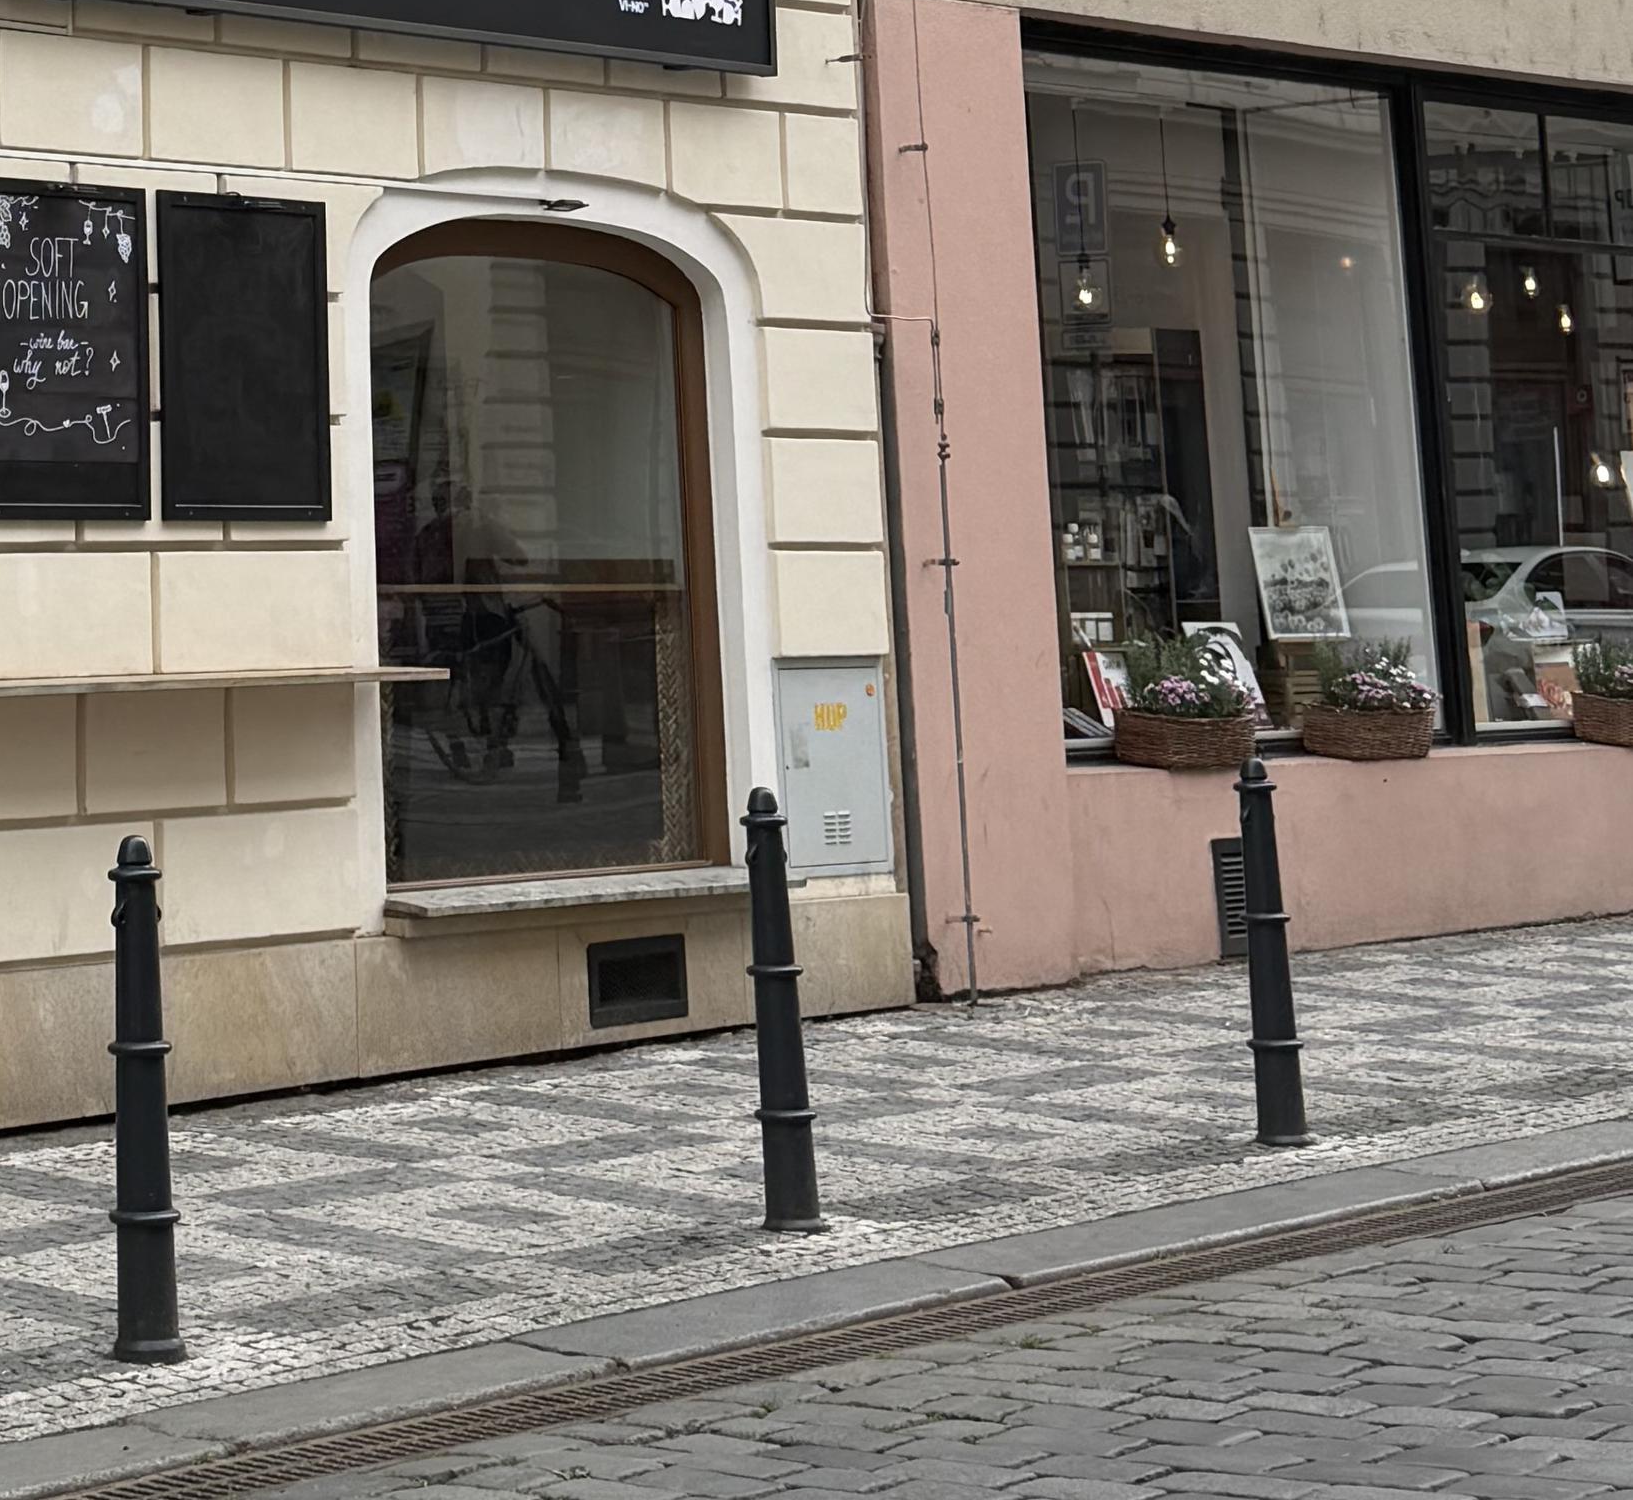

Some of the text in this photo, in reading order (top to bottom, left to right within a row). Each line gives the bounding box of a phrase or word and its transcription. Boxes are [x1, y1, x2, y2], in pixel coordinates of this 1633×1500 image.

[25, 237, 79, 278] SOFT
[2, 279, 88, 321] OPENING
[13, 349, 46, 390] why
[815, 702, 847, 731] HUP
